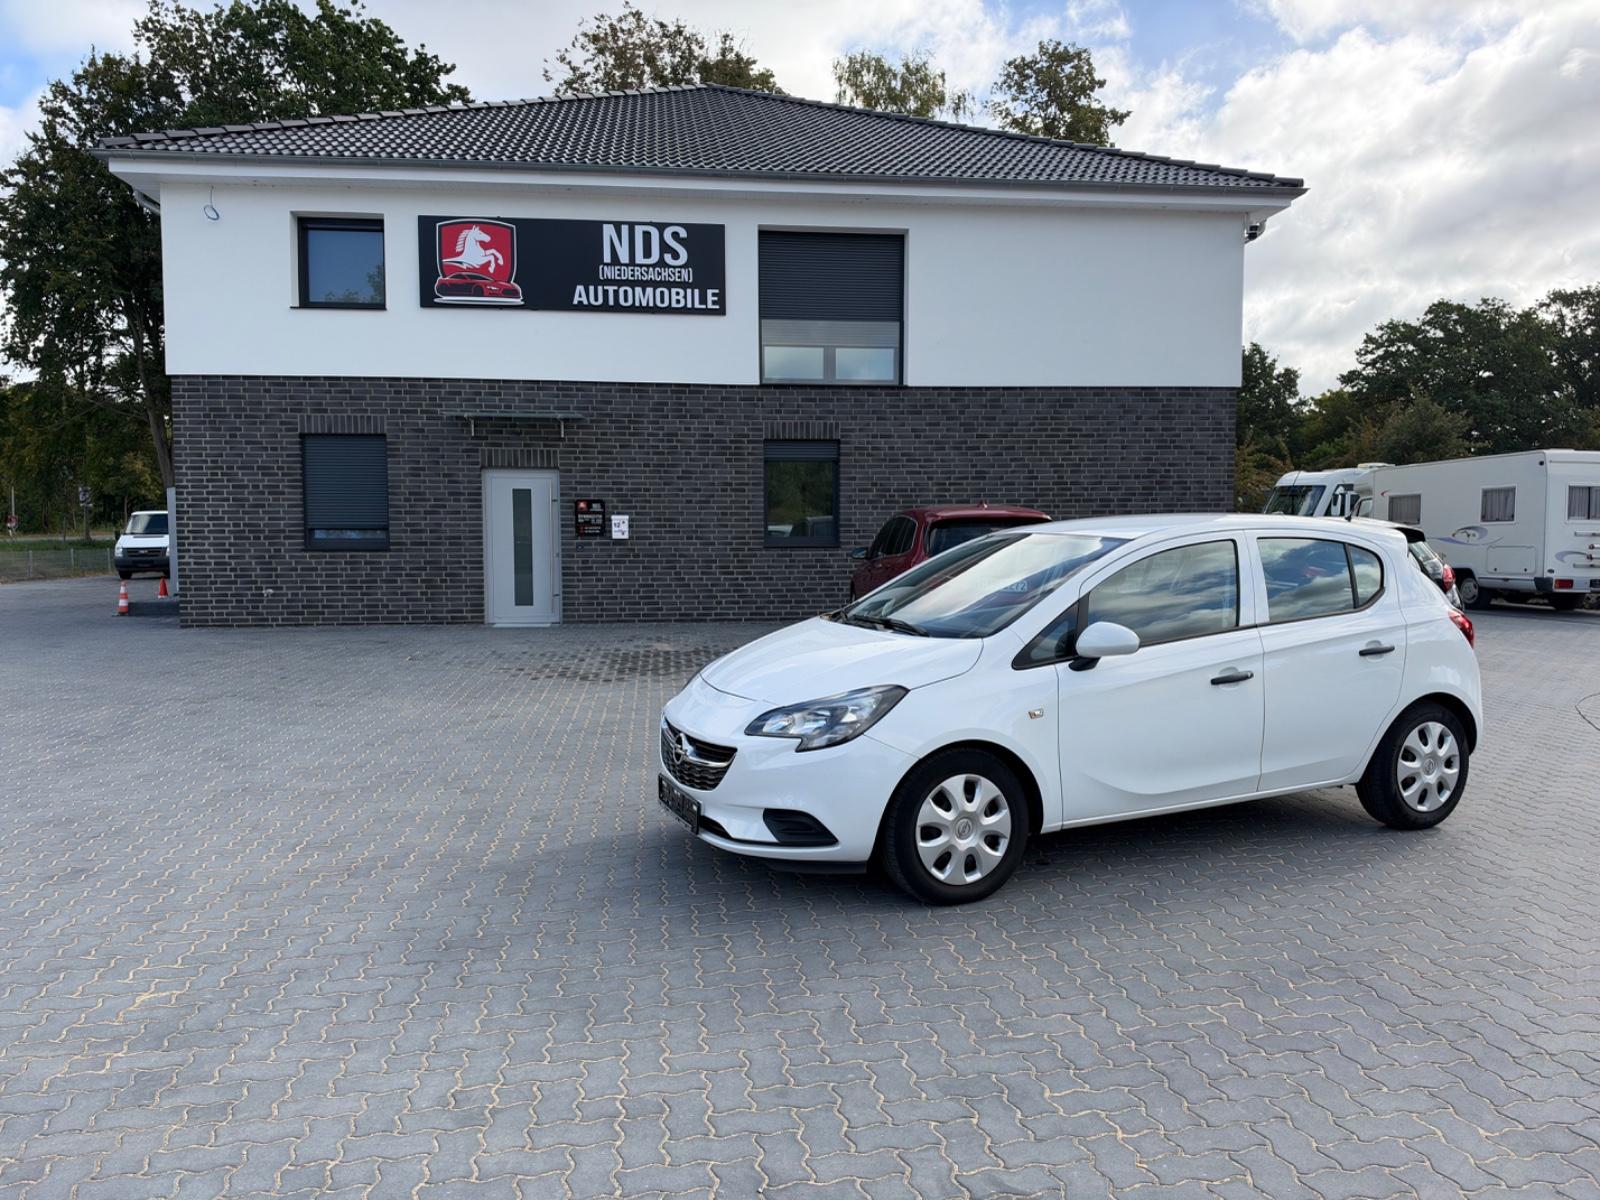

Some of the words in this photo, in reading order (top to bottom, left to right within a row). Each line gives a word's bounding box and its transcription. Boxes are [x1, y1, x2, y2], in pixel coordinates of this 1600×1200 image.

[603, 223, 688, 267] NDS
[599, 264, 693, 283] (NIEDERSACHSEN)
[572, 284, 720, 309] AUTOMOBILE
